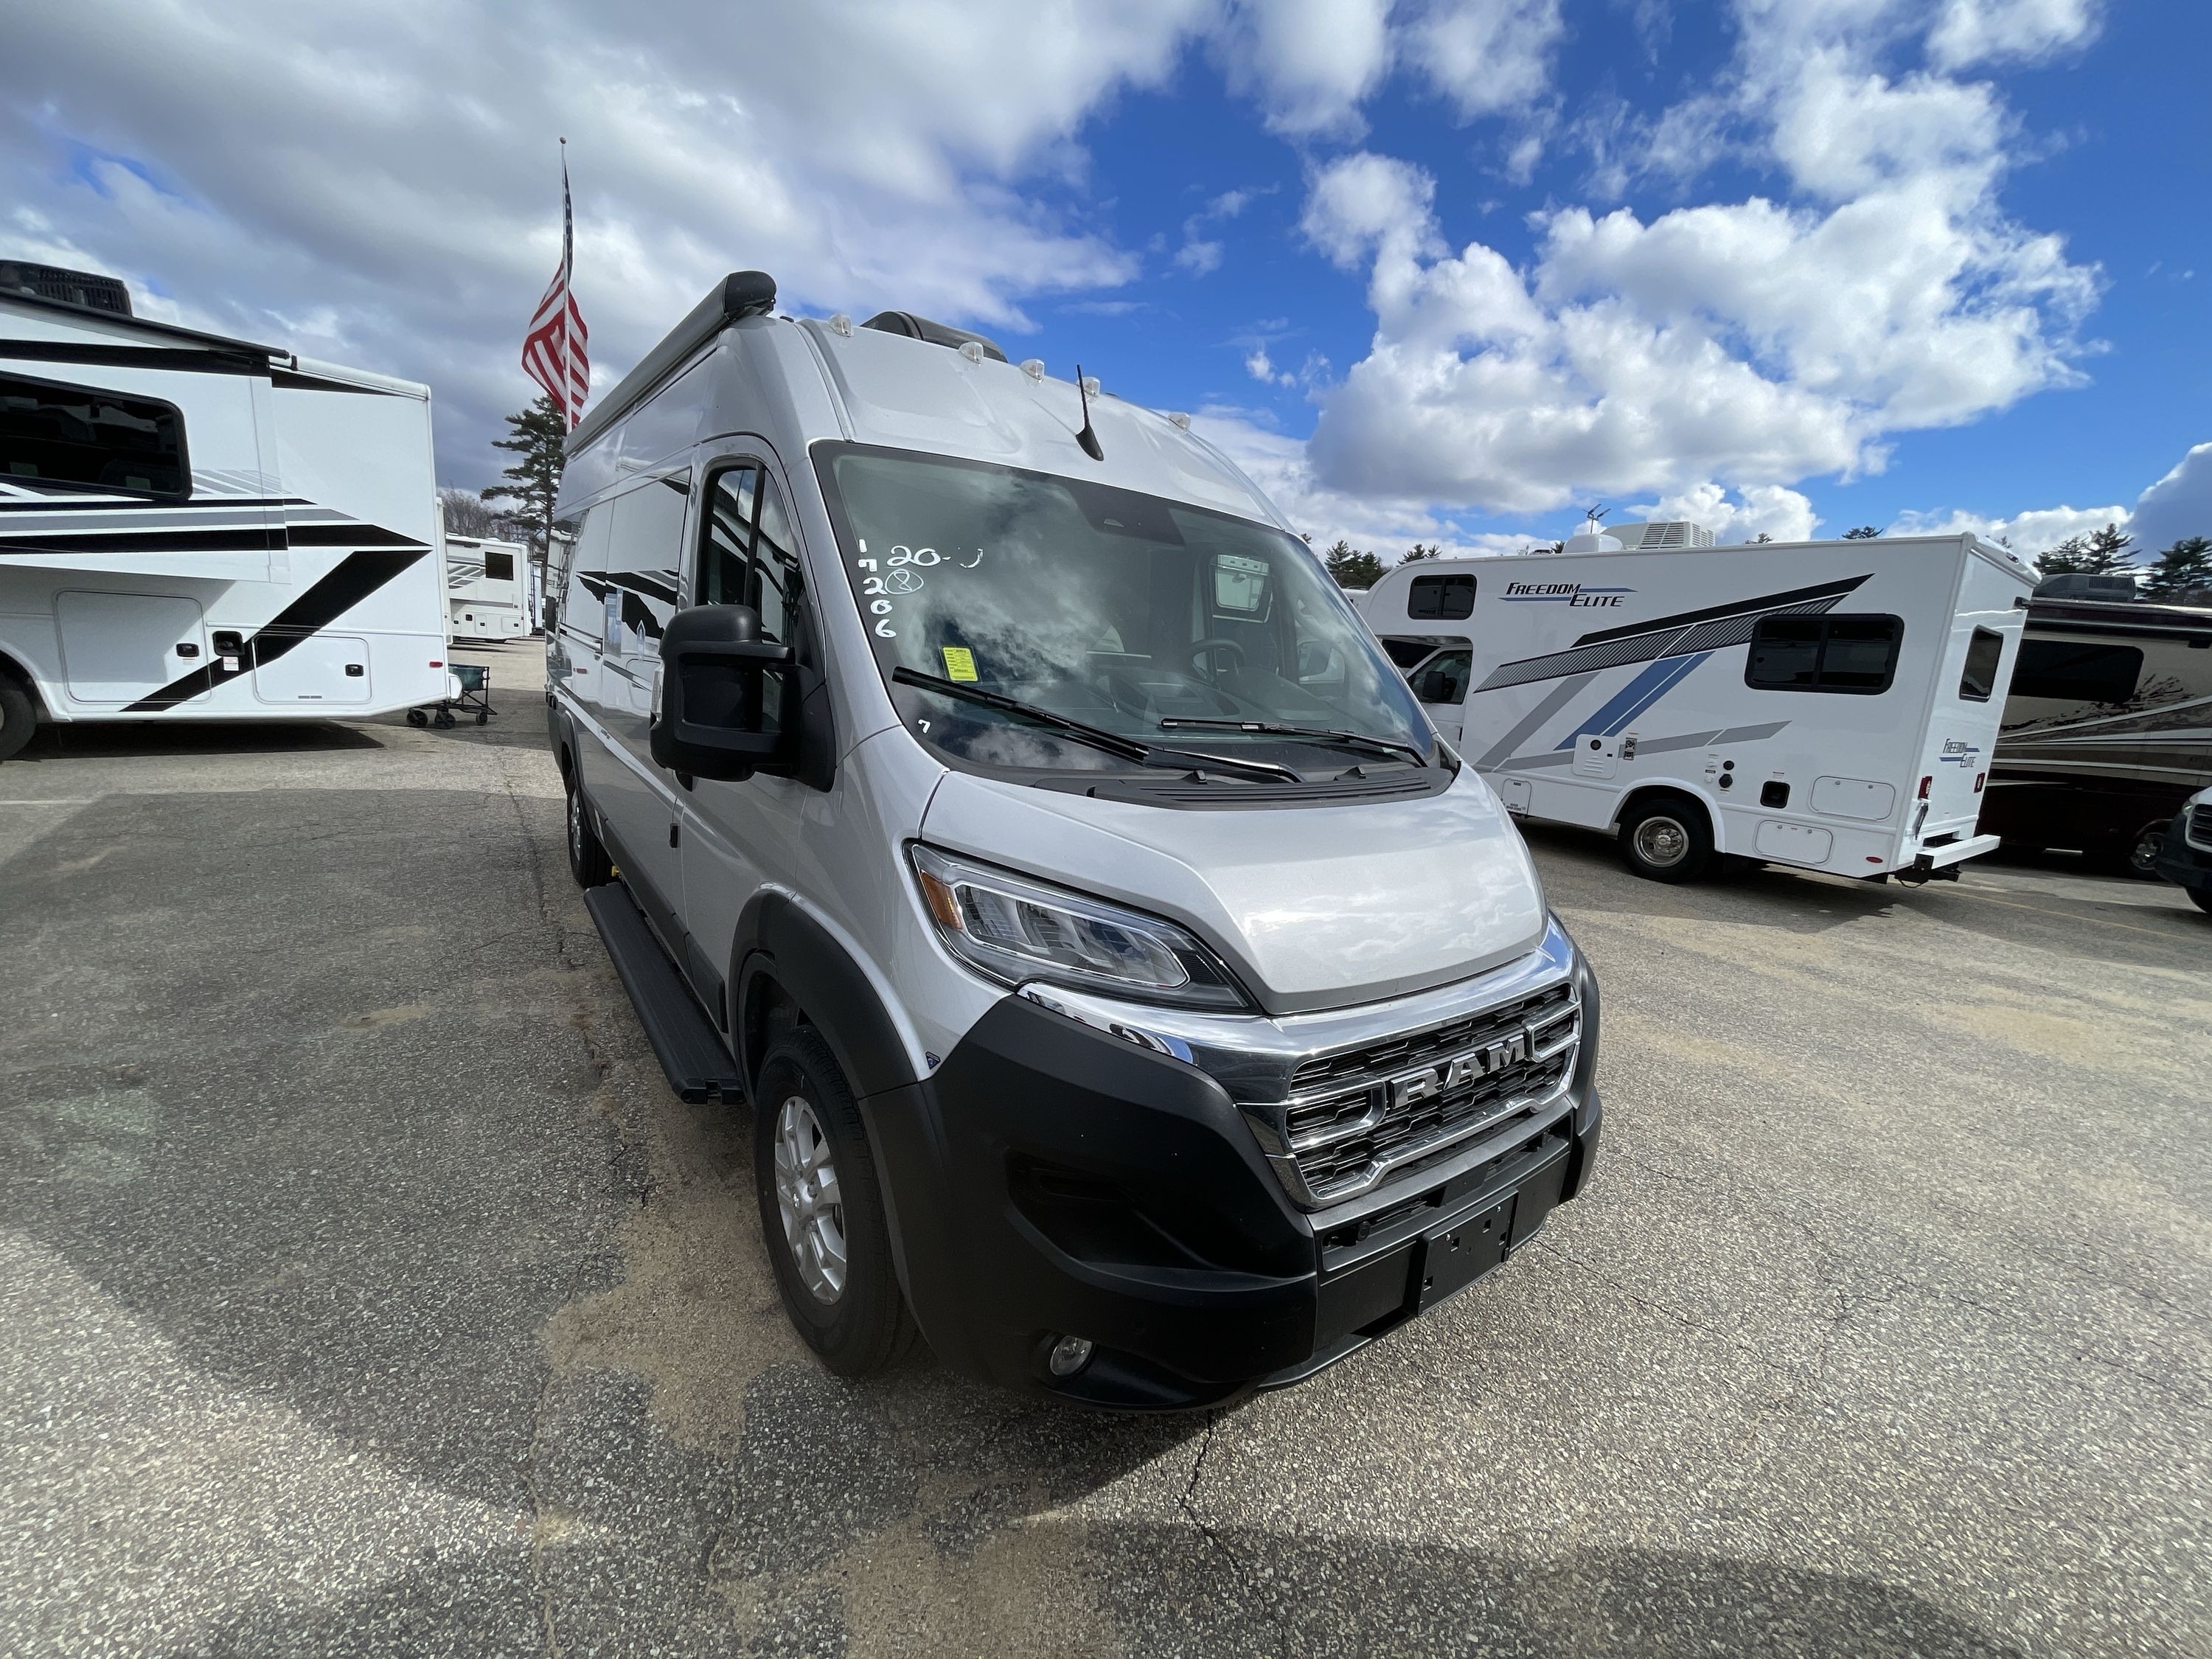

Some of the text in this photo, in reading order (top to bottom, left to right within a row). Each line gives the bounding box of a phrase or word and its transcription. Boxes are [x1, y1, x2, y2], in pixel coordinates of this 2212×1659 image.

[1506, 582, 1582, 595] FREEDOM
[1569, 594, 1625, 607] ELITE
[1942, 738, 1969, 754] FREEDOM
[1959, 753, 1977, 768] ELITE
[1389, 1034, 1526, 1110] RAM
